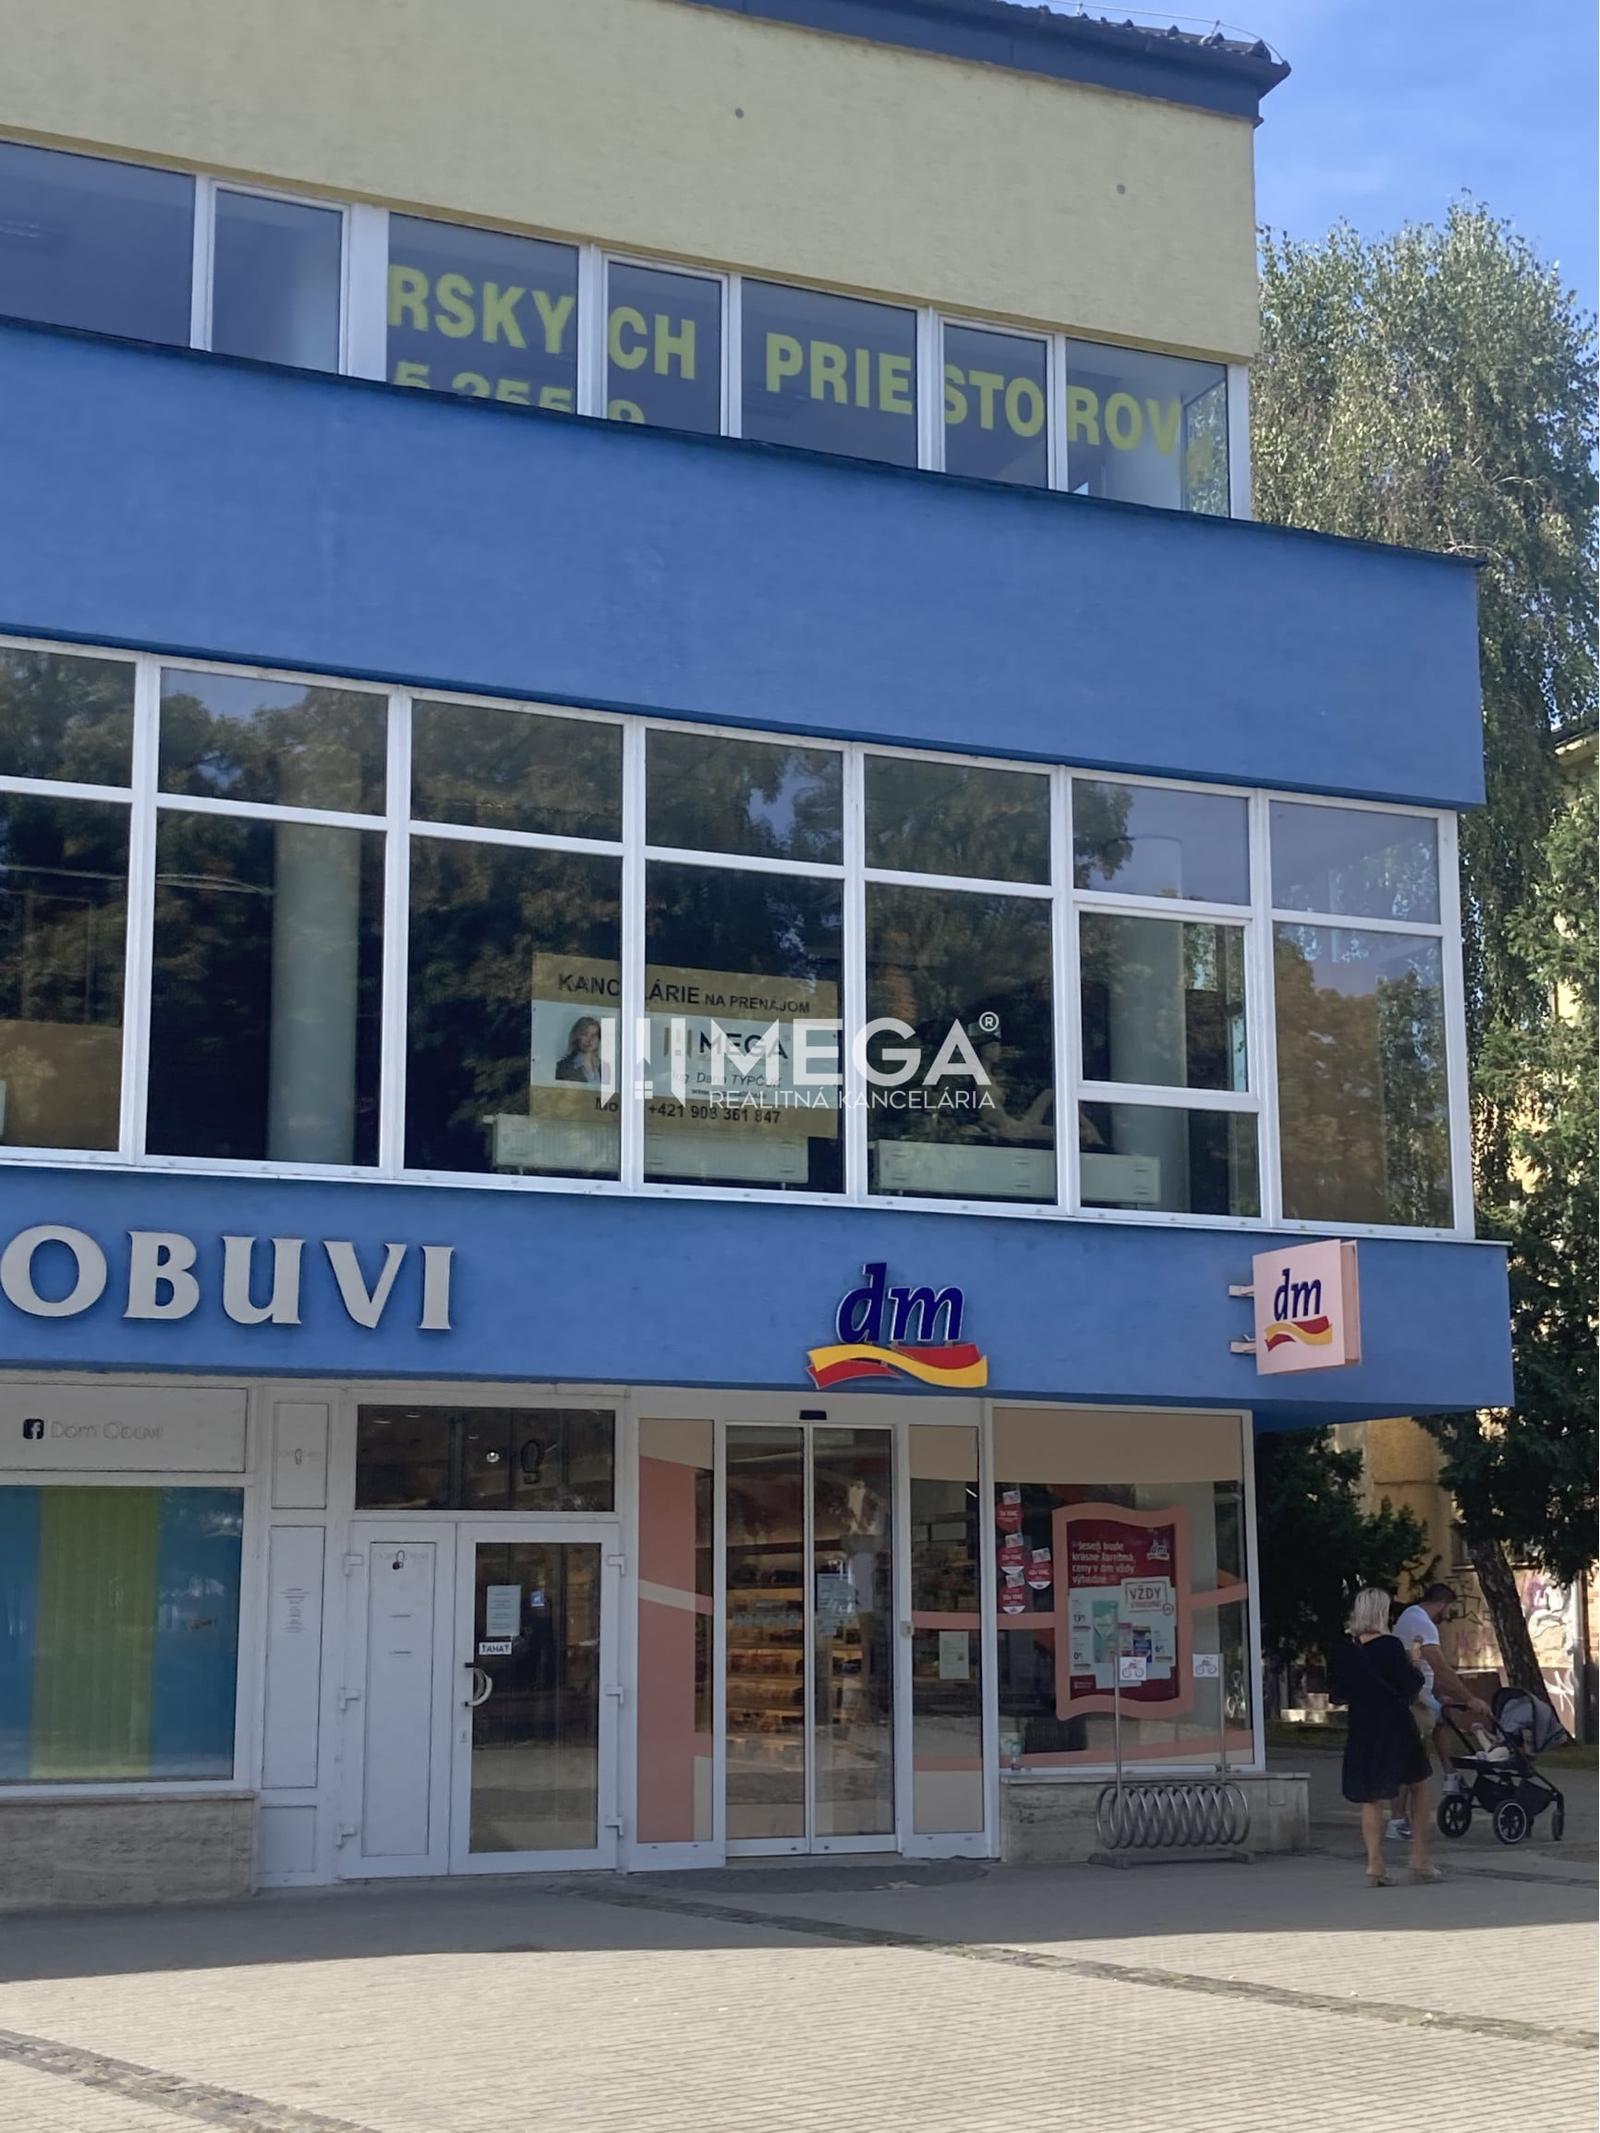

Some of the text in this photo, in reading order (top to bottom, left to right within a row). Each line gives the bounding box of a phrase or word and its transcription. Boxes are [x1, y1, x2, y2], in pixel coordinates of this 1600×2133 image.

[558, 973, 700, 1004] KANCÁRIE
[705, 994, 726, 1007] NA
[649, 1103, 685, 1117] +421
[723, 1107, 749, 1121] 361
[754, 1109, 781, 1123] 847
[0, 1224, 455, 1330] OBUVI
[1274, 1268, 1322, 1321] dm
[836, 1262, 965, 1343] dm
[1129, 1584, 1161, 1600] VŽDY
